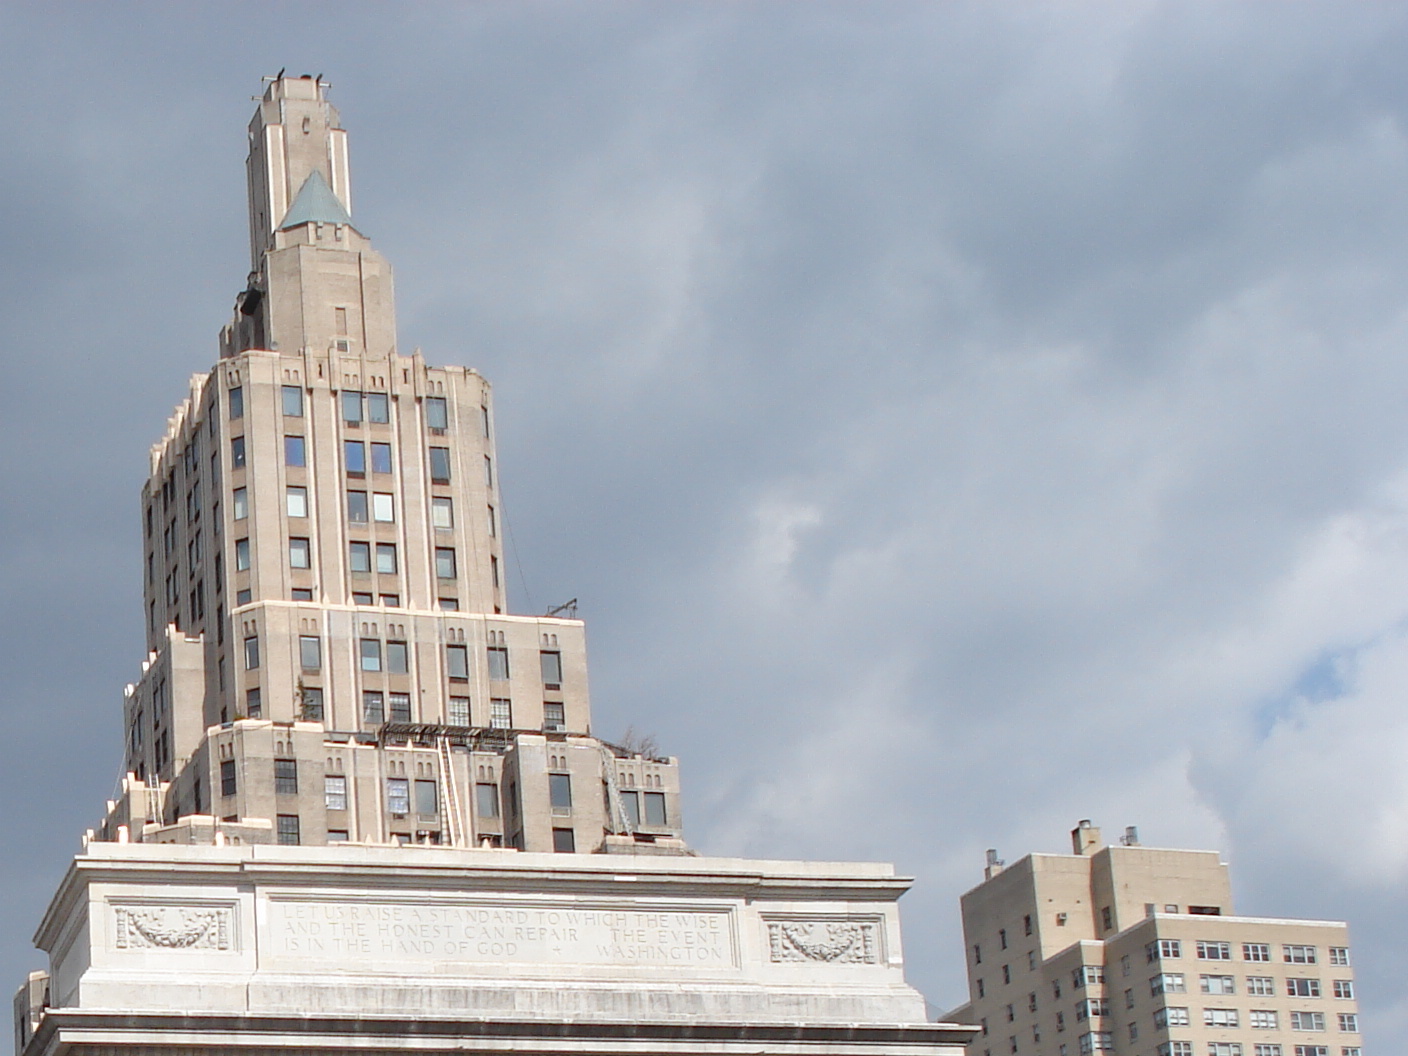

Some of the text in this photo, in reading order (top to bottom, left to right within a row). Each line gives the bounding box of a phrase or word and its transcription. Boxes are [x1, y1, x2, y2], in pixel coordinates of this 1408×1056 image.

[283, 905, 718, 930] LET US RAISE A STANDARD TO WHICH THE WISE
[285, 921, 721, 945] AND THE HONEST CAN REPAIR THE EVENT
[285, 938, 722, 960] IS IN THE HAND OF GOD WASHINGTON
